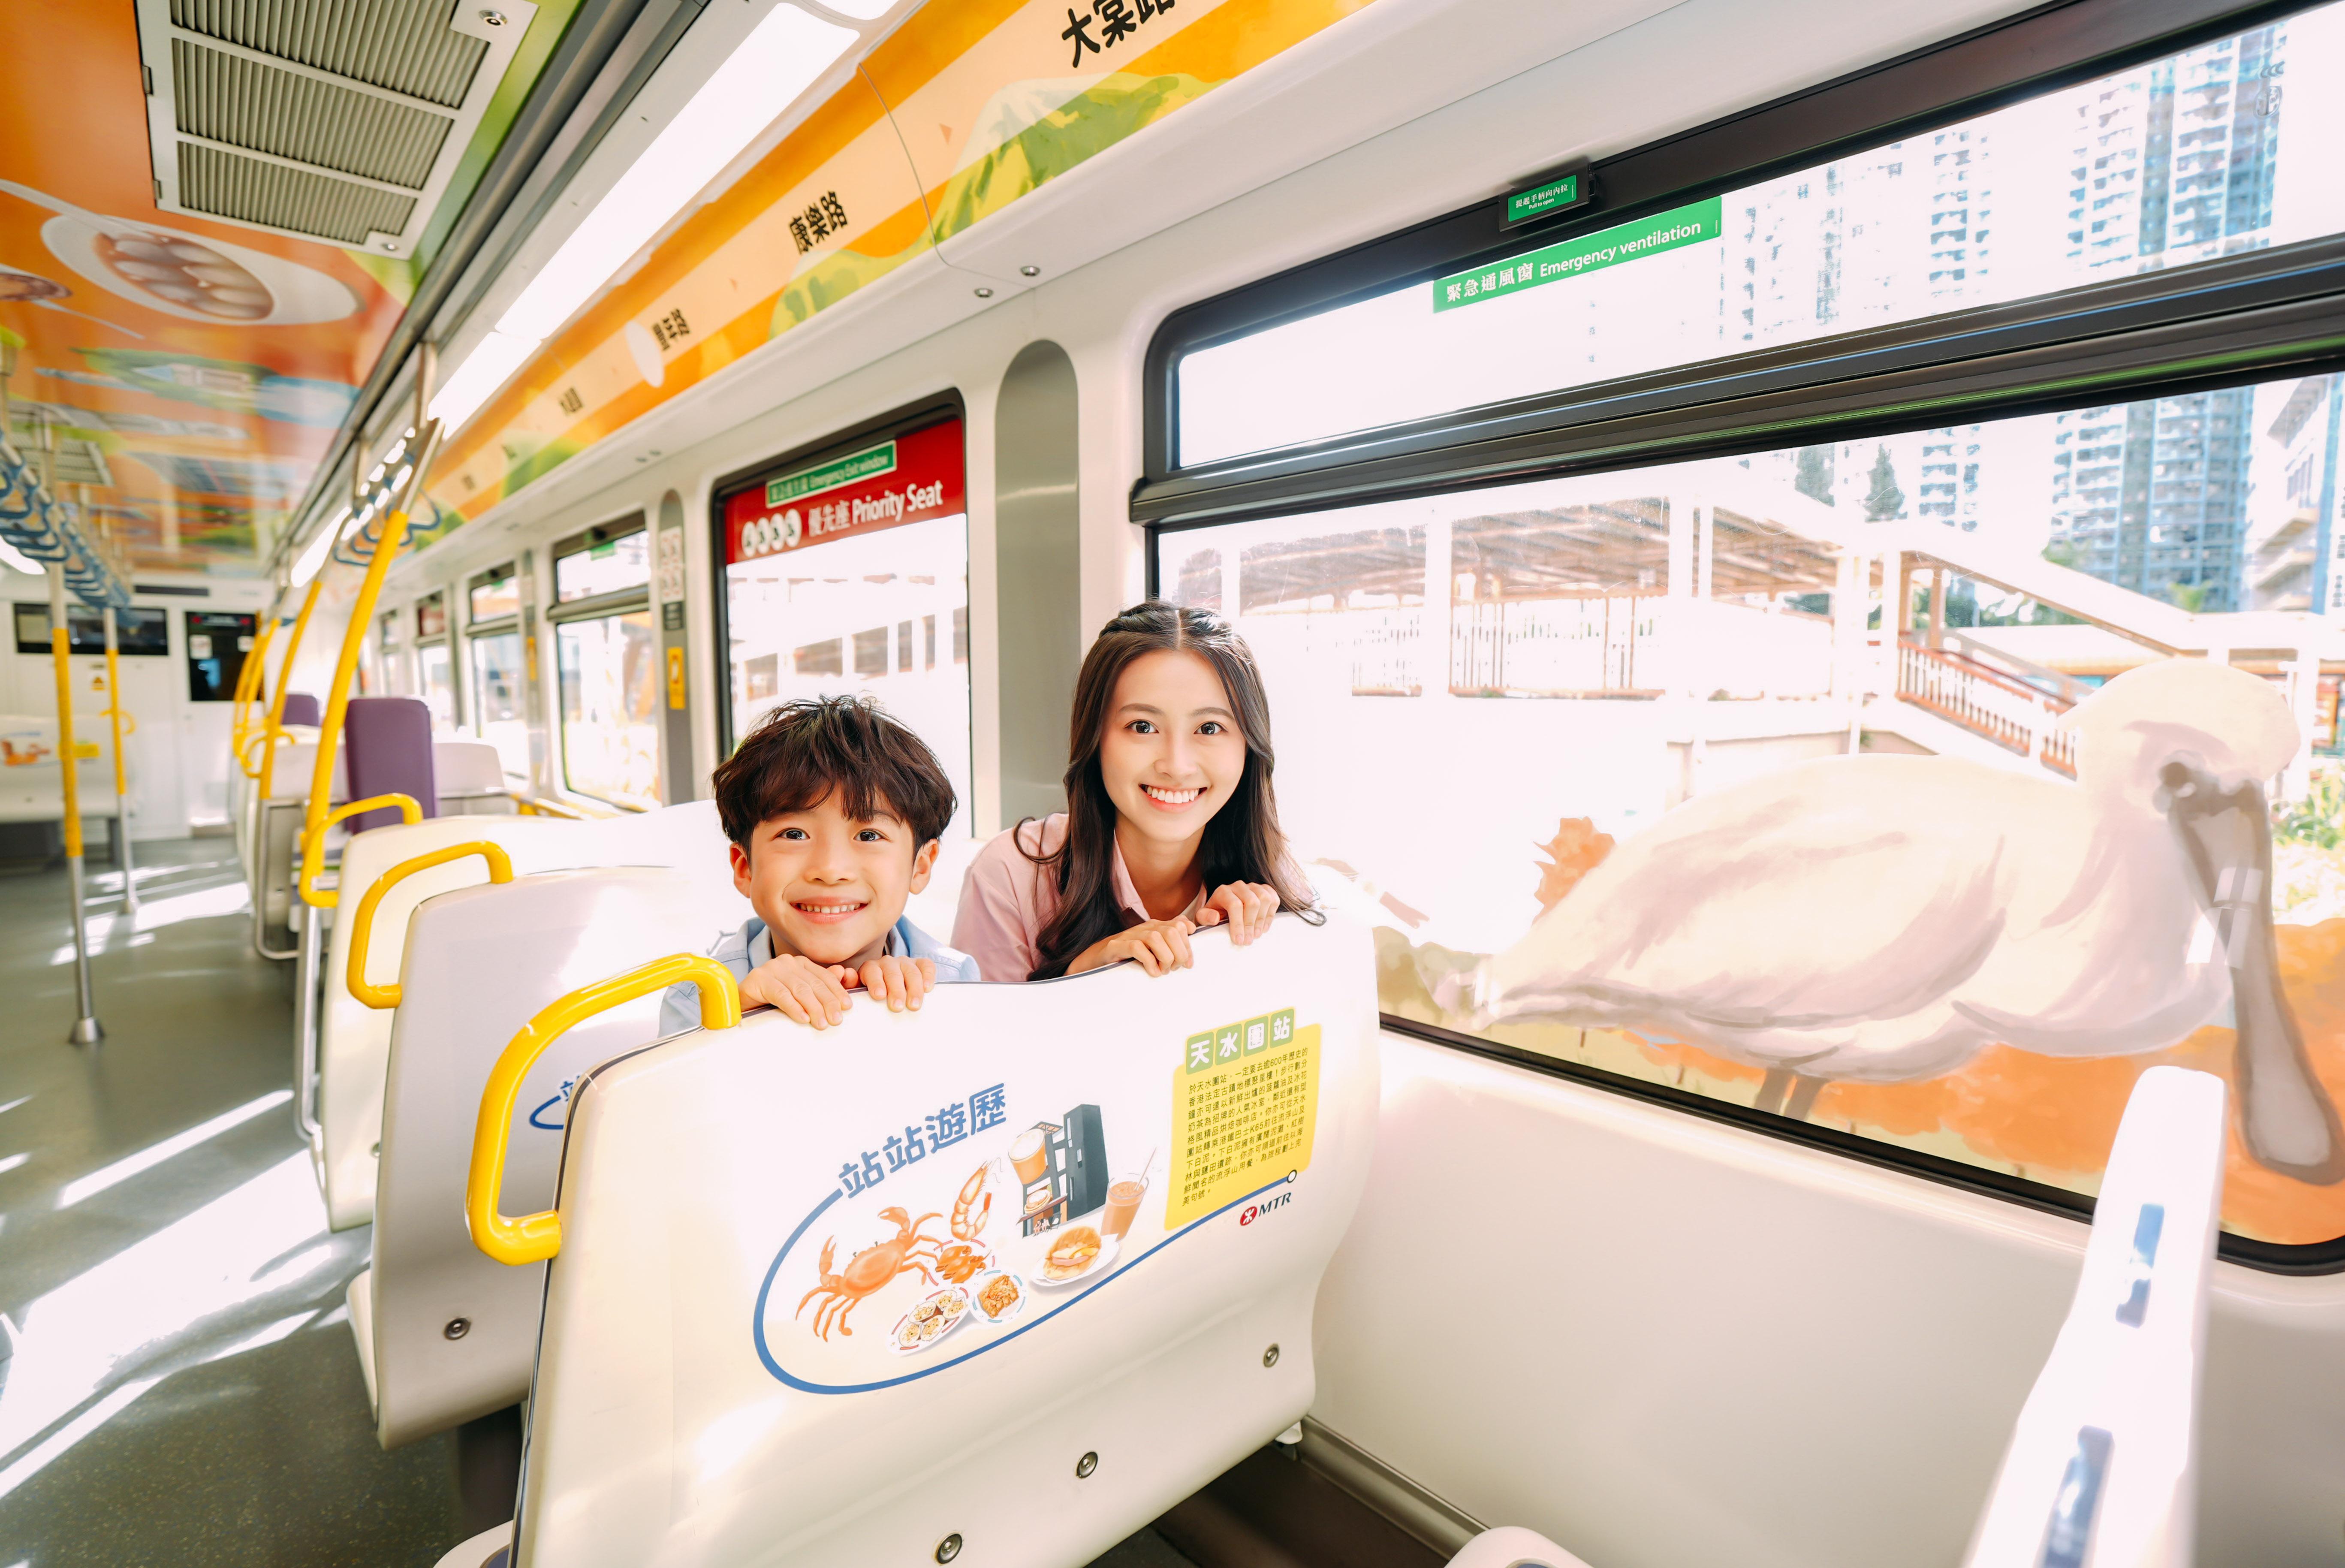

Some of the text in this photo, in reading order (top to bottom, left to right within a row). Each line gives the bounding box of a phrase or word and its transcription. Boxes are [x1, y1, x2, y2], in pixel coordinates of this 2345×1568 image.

[790, 191, 847, 254] 康樂路
[1447, 262, 1534, 302] 緊急通風窗
[1540, 247, 1617, 277] Emergency
[1620, 222, 1701, 255] ventilation
[808, 480, 943, 537] 優先座 Priority Seat
[1190, 1016, 1290, 1068] 天水圍站
[838, 1083, 1006, 1199] 站站遊歷
[1259, 1192, 1291, 1217] MTR
